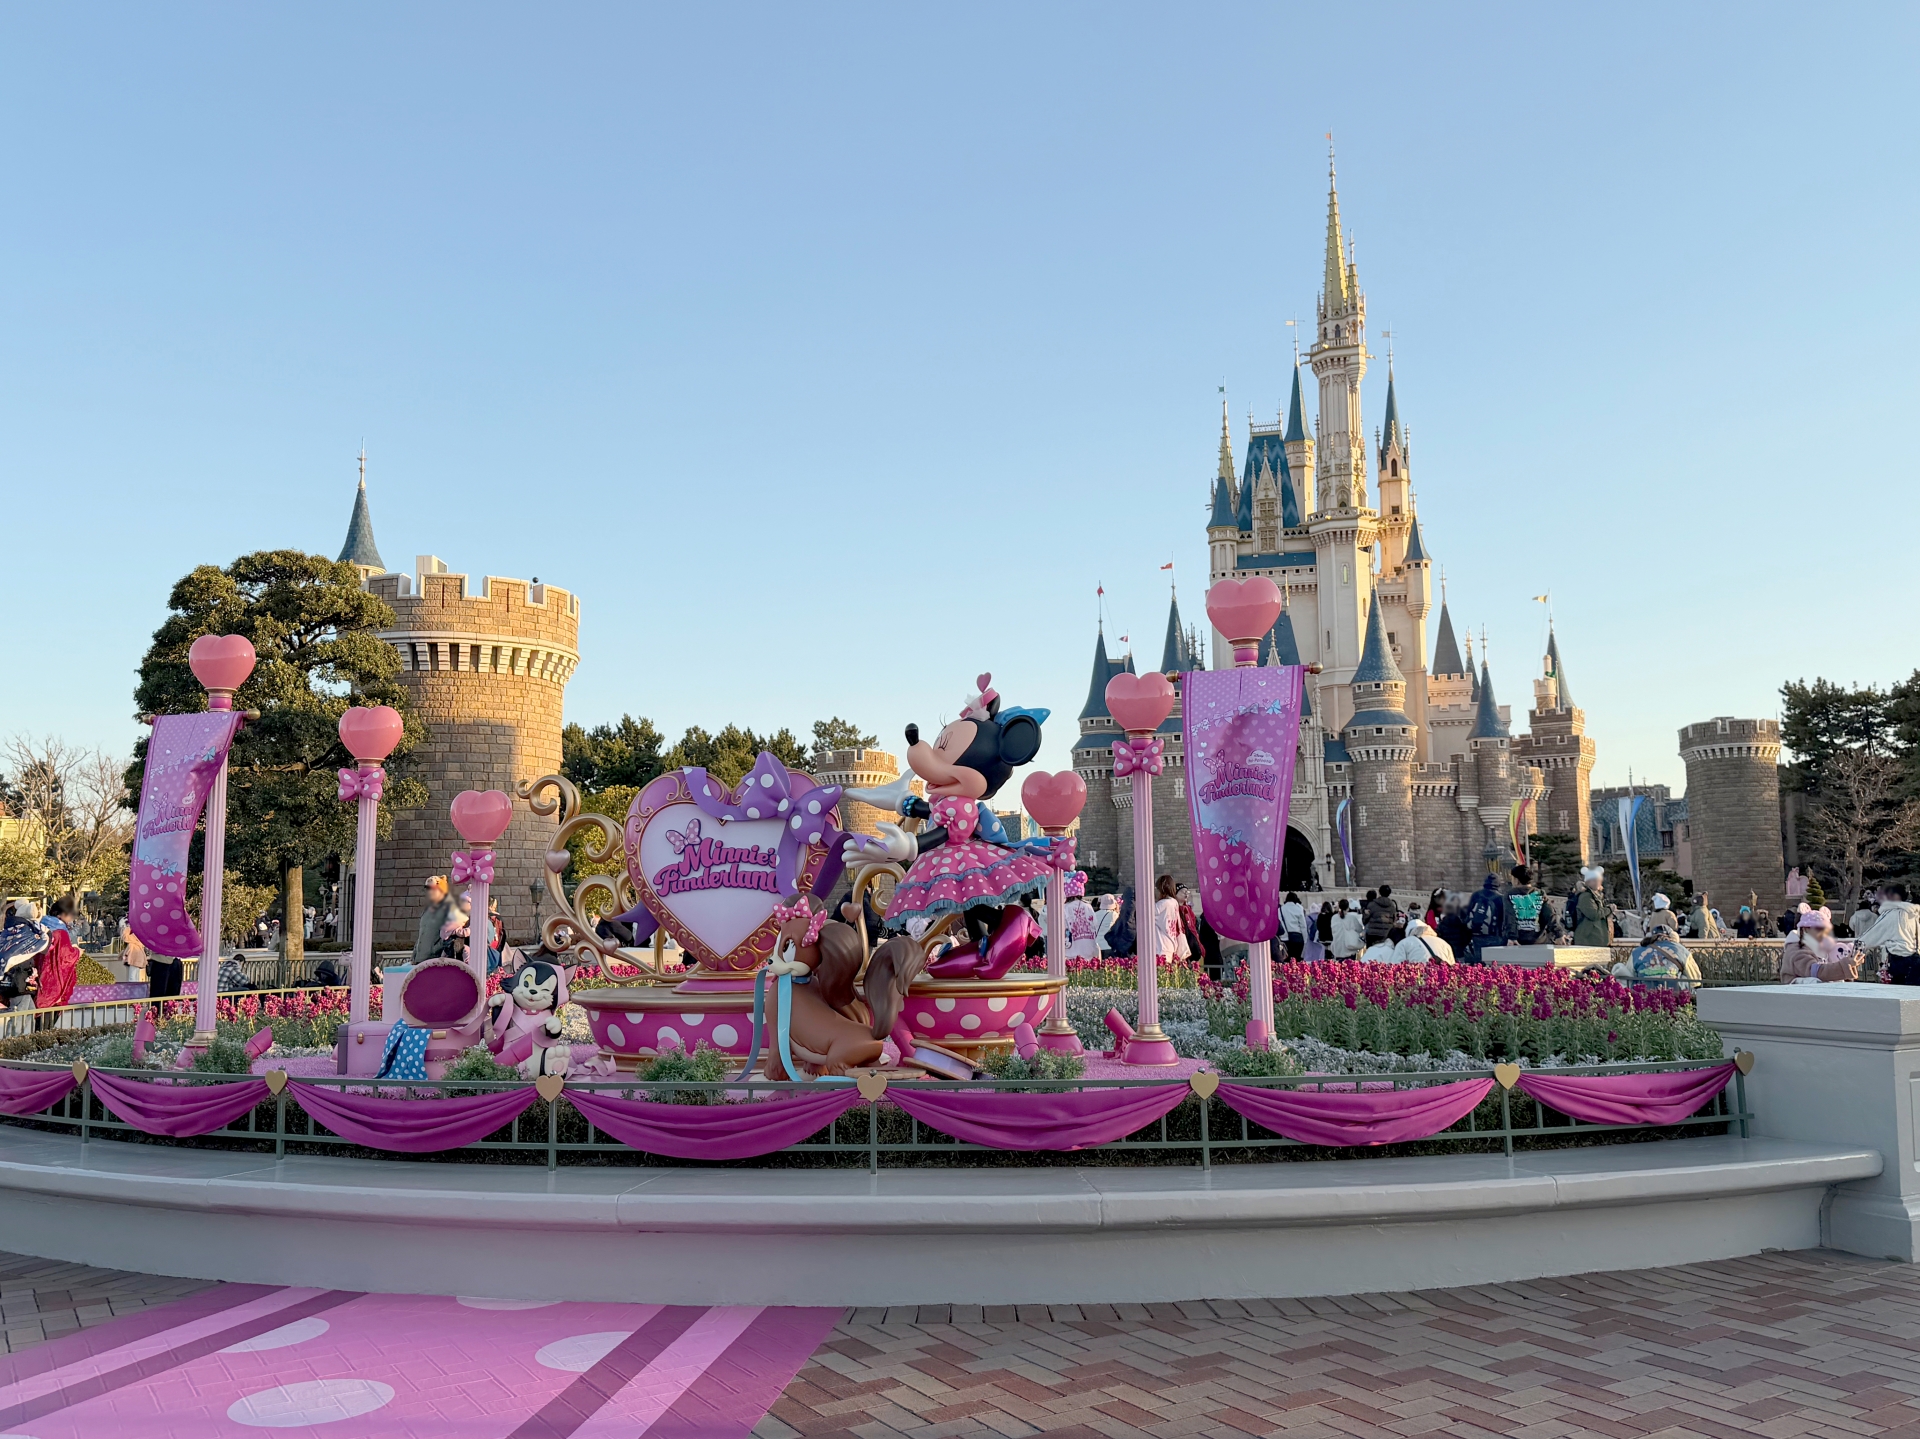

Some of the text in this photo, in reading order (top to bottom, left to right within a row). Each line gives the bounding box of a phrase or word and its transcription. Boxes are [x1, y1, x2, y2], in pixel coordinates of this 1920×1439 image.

[1199, 774, 1278, 804] Funderland
[1214, 761, 1273, 789] Minnie's
[679, 837, 777, 876] Minnie's
